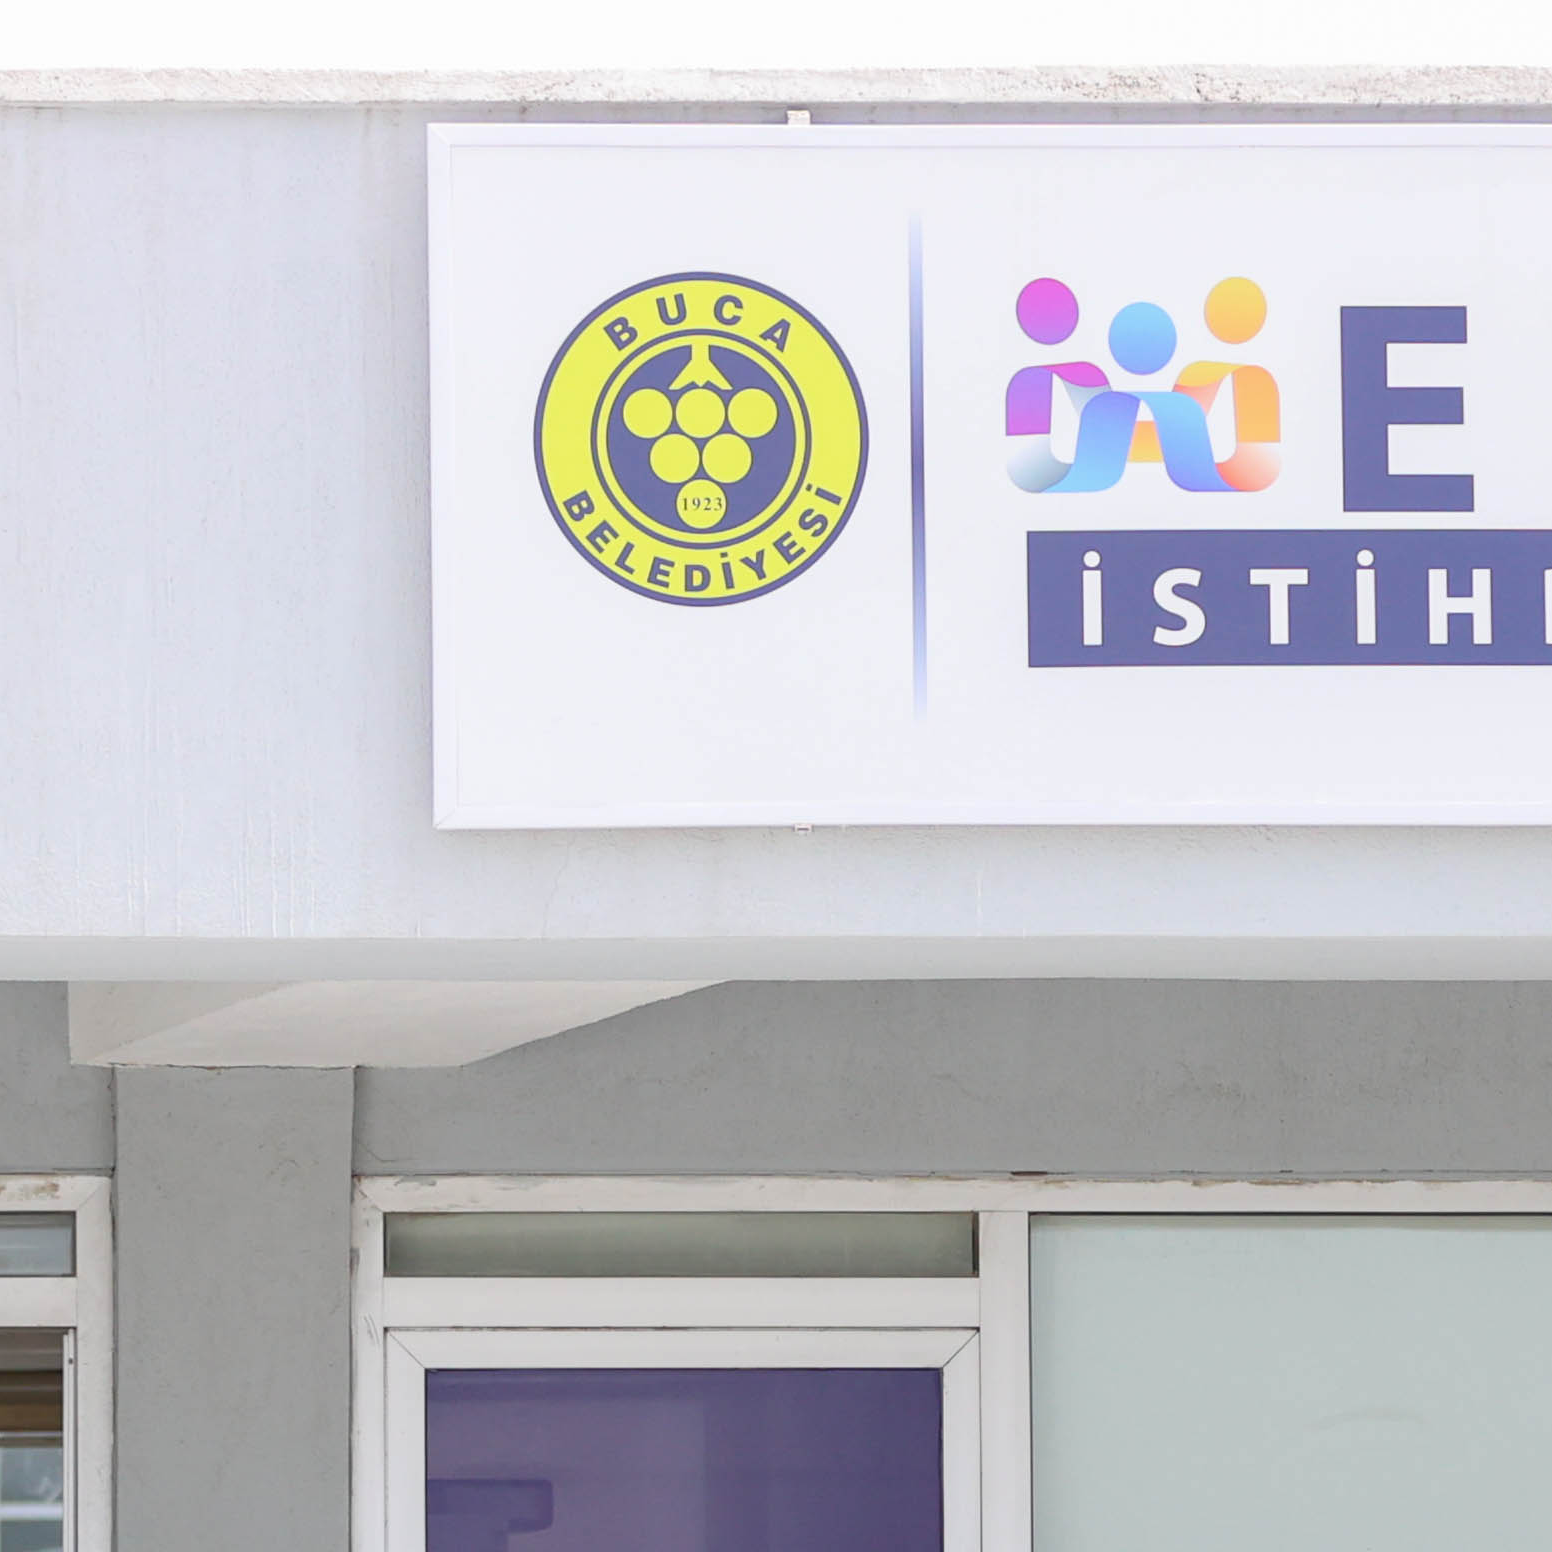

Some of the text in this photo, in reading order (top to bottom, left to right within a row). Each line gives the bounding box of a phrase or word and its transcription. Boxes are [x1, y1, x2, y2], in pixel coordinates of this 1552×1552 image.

[602, 292, 792, 353] BUCA
[680, 496, 724, 512] 1923
[562, 483, 844, 593] BELEDİYESİ
